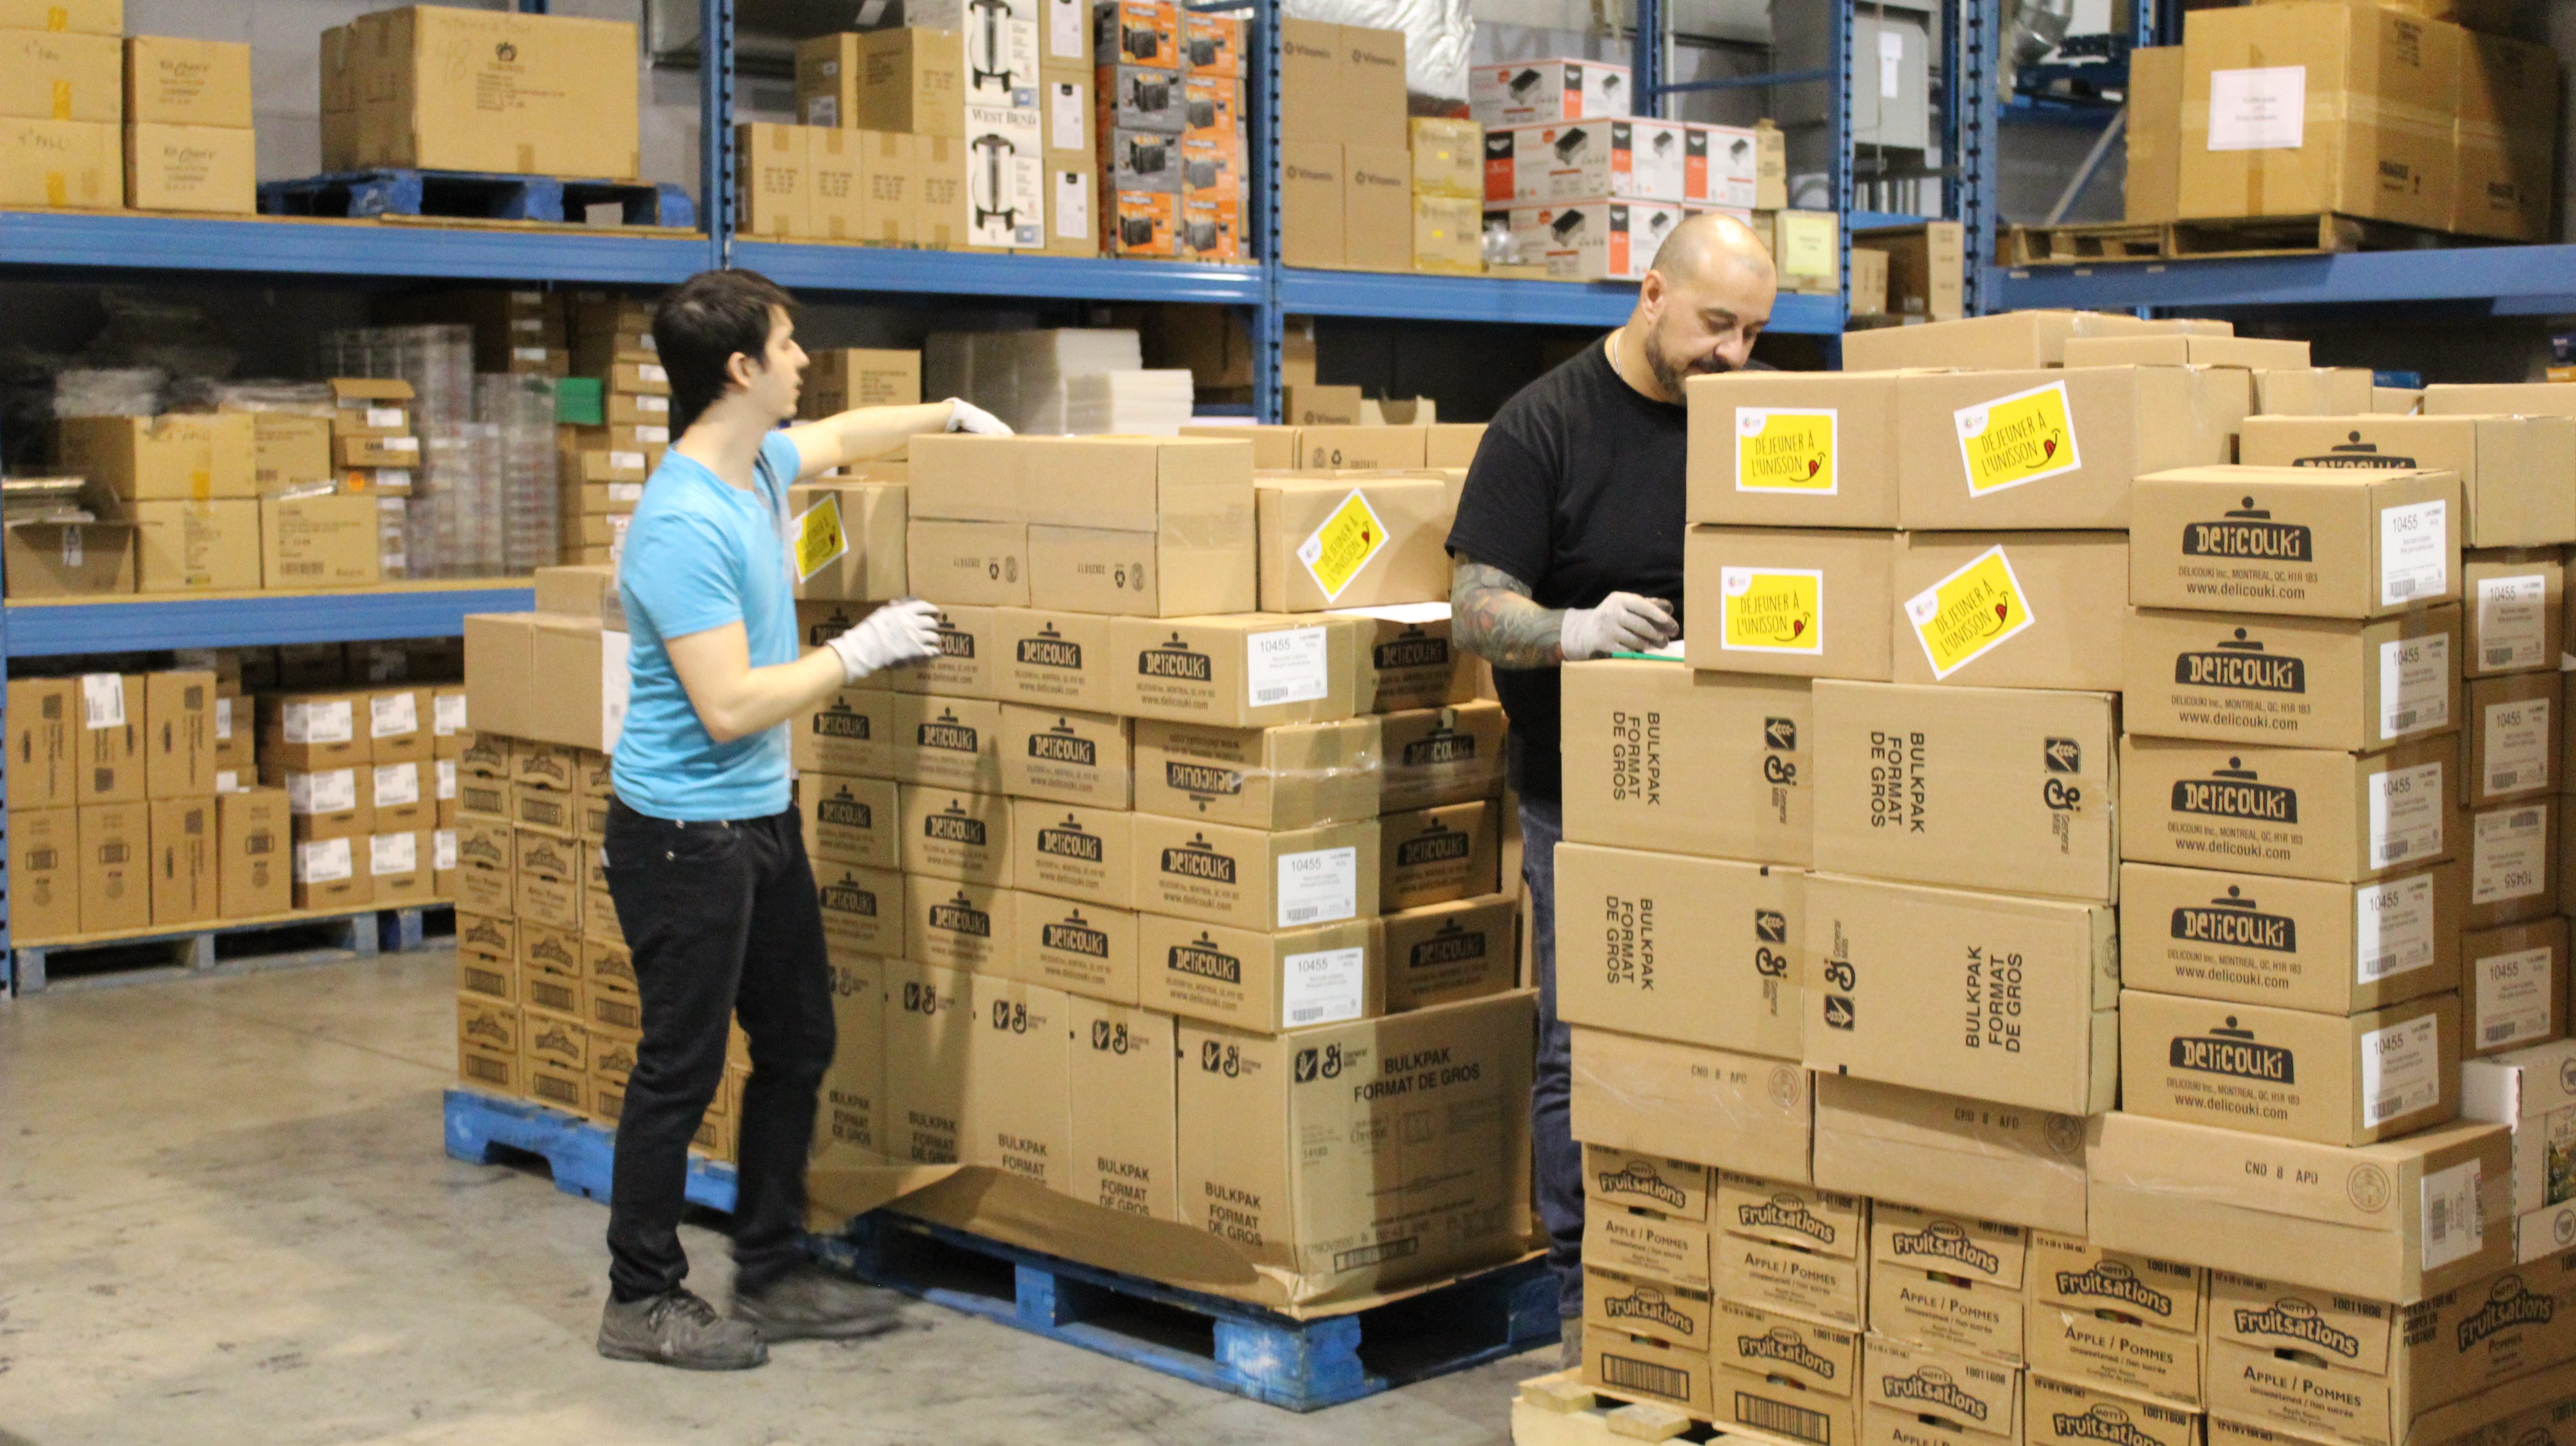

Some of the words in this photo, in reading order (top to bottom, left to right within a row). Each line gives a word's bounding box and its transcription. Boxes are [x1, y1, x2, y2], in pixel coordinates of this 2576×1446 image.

[1756, 433, 1803, 455] DÉJEUNER
[1982, 416, 2035, 454] DÉJEUNER
[1752, 455, 1802, 477] L'UNISSON
[1982, 439, 2037, 477] L'UNISSON
[2393, 515, 2418, 532] 10455
[2179, 566, 2214, 578] DELICOUKI
[1741, 592, 1788, 614] DÉJEUNER
[2187, 582, 2305, 599] www.delicouki.com
[2490, 586, 2516, 602] 10455
[1935, 587, 1984, 635] DÉJEUNER
[1737, 615, 1787, 636] L'UNISSON
[1940, 608, 1992, 657] L'UNISSON
[1260, 640, 1290, 653] 10455
[2394, 647, 2419, 665] 10455
[2171, 695, 2207, 706] DELICOUKI
[1614, 712, 1625, 737] DE
[2180, 712, 2298, 730] www.delicouki.com
[2497, 711, 2521, 727] 10455
[1628, 716, 1640, 798] FORMAT
[1871, 731, 1885, 759] DE
[1648, 712, 1660, 805] BULKPAK
[1614, 745, 1626, 800] GROS
[1888, 737, 1901, 825] FORMAT
[1910, 732, 1924, 833] BULKPAK
[1871, 767, 1885, 827] GROS
[2384, 777, 2410, 796] 10455
[2061, 814, 2070, 854] General
[2168, 822, 2202, 833] DELICOUKI
[2176, 839, 2290, 860] www.delicouki.com
[1291, 858, 1321, 873] 10455
[2505, 871, 2532, 889] 10455
[1607, 896, 1618, 921] DE
[2370, 891, 2398, 911] 10455
[1607, 927, 1620, 984] GROS
[1622, 902, 1634, 984] FORMAT
[1641, 899, 1653, 991] BULKPAK
[2168, 948, 2201, 960] DELICOUKI
[1298, 959, 1327, 973] 10455
[2175, 965, 2289, 989] www.delicouki.com
[2490, 962, 2519, 981] 10455
[1966, 945, 1982, 1048] BULKPAK
[2007, 953, 2023, 1016] GROS
[1989, 954, 2004, 1046] FORMAT
[2006, 1024, 2020, 1052] DE
[2375, 1033, 2403, 1055] 10455
[1385, 1049, 1450, 1073] BULKPAK
[1355, 1077, 1413, 1102] FORMAT
[1419, 1072, 1436, 1089] DE
[1441, 1063, 1480, 1085] GROS
[2167, 1077, 2201, 1089] DELICOUKI
[2175, 1094, 2288, 1120] www.delicouki.com
[998, 1134, 1046, 1157] BULKPAK
[1002, 1154, 1045, 1175] FORMAT
[1098, 1157, 1149, 1182] BULKPAK
[1101, 1179, 1146, 1200] FORMAT
[1206, 1181, 1260, 1209] BULKPAK
[1600, 1172, 1685, 1208] Fruitsations
[1210, 1204, 1258, 1229] FORMAT
[1739, 1201, 1835, 1244] Fruitsations
[1209, 1220, 1222, 1235] DE
[1227, 1226, 1262, 1246] GROS
[1893, 1231, 1999, 1274] Fruitsations
[1901, 1288, 1936, 1308] APPLE
[1950, 1299, 1999, 1323] POMMES
[2056, 1271, 2171, 1316] Fruitsations
[1606, 1297, 1693, 1335] Fruitsations
[2065, 1325, 2105, 1346] APPLE
[2120, 1338, 2173, 1364] POMMES
[2235, 1309, 2359, 1358] Fruitsations
[1739, 1335, 1834, 1379] Fruitsations
[1883, 1375, 1987, 1421] Fruitsations
[2244, 1366, 2287, 1387] APPLE
[2303, 1379, 2361, 1407] POMMES
